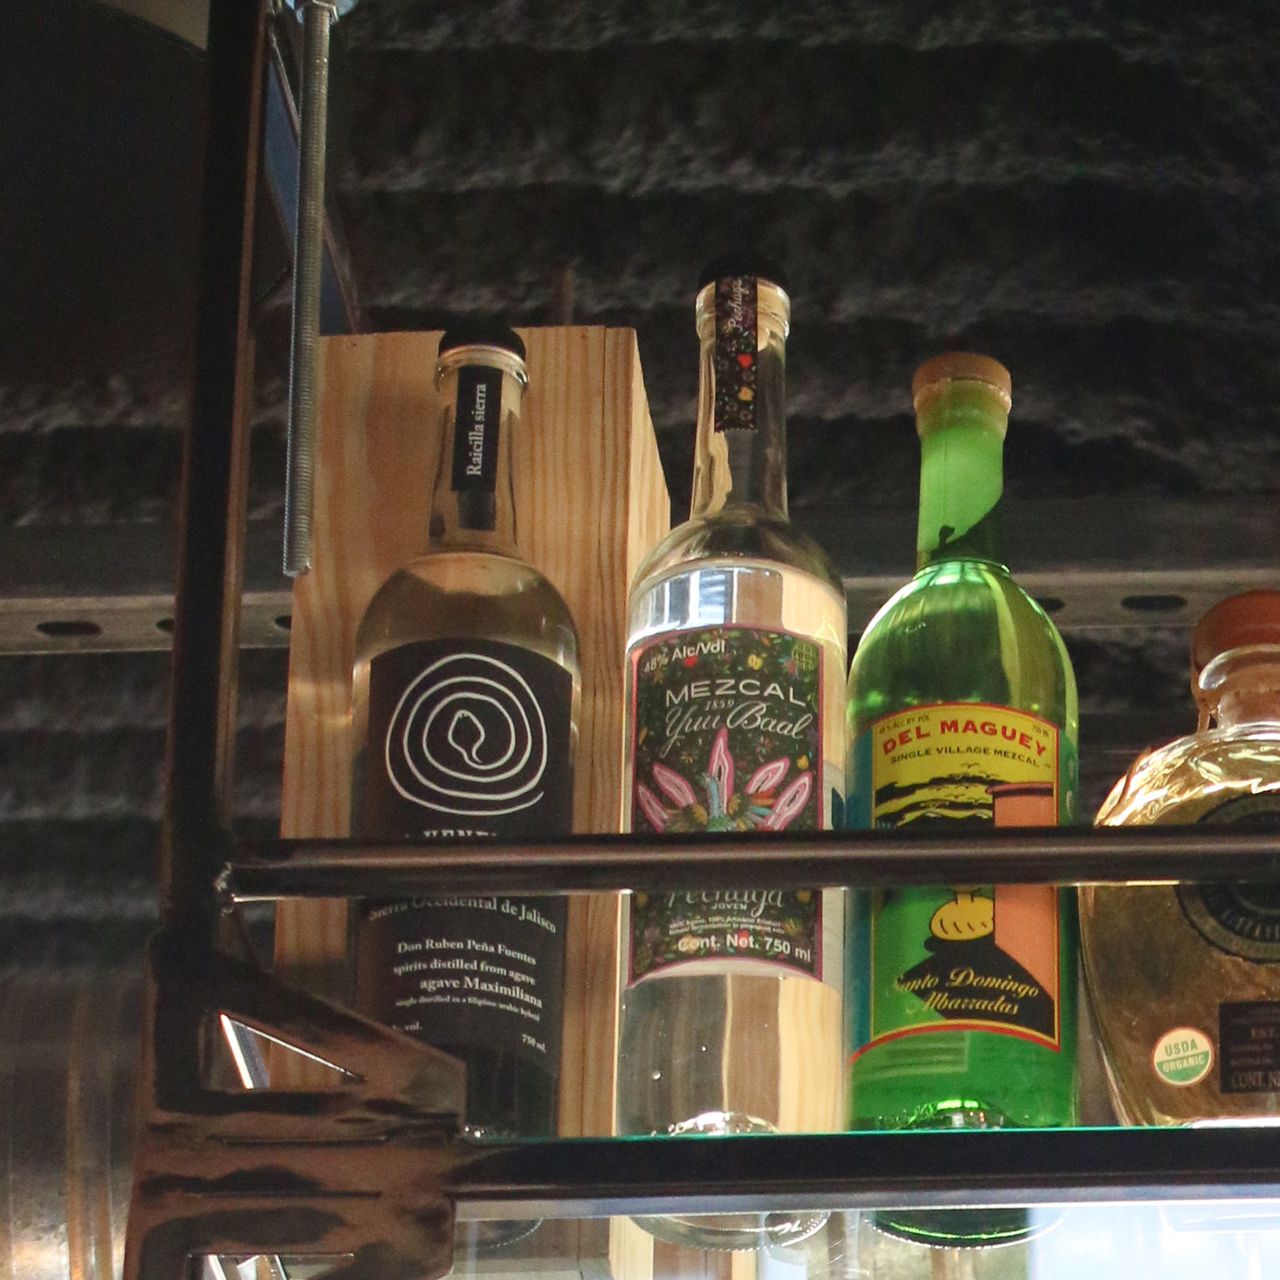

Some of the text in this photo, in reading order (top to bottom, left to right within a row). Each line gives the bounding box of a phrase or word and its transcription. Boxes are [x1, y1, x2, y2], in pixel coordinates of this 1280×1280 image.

[466, 383, 487, 475] Raicilla sierra
[666, 679, 808, 707] MEZCAL
[726, 700, 813, 739] Baal
[883, 726, 930, 755] DEL
[940, 719, 1048, 757] MAGUEY
[891, 744, 1040, 768] SINGLE VILLAGE MEZCAL
[411, 895, 498, 911] Occidental
[501, 899, 518, 915] de
[518, 903, 558, 935] Jalisco
[398, 941, 422, 955] Don
[467, 939, 495, 954] Peña
[498, 943, 537, 966] Fuentes
[678, 933, 811, 962] Cont. Net. 750 ml
[393, 958, 537, 986] spirits distilled from agave
[894, 966, 1040, 1001] Santo Domingo
[420, 976, 543, 1009] agave Maximiliana
[1164, 1039, 1198, 1057] USDA
[1162, 1053, 1207, 1073] ORGANIC
